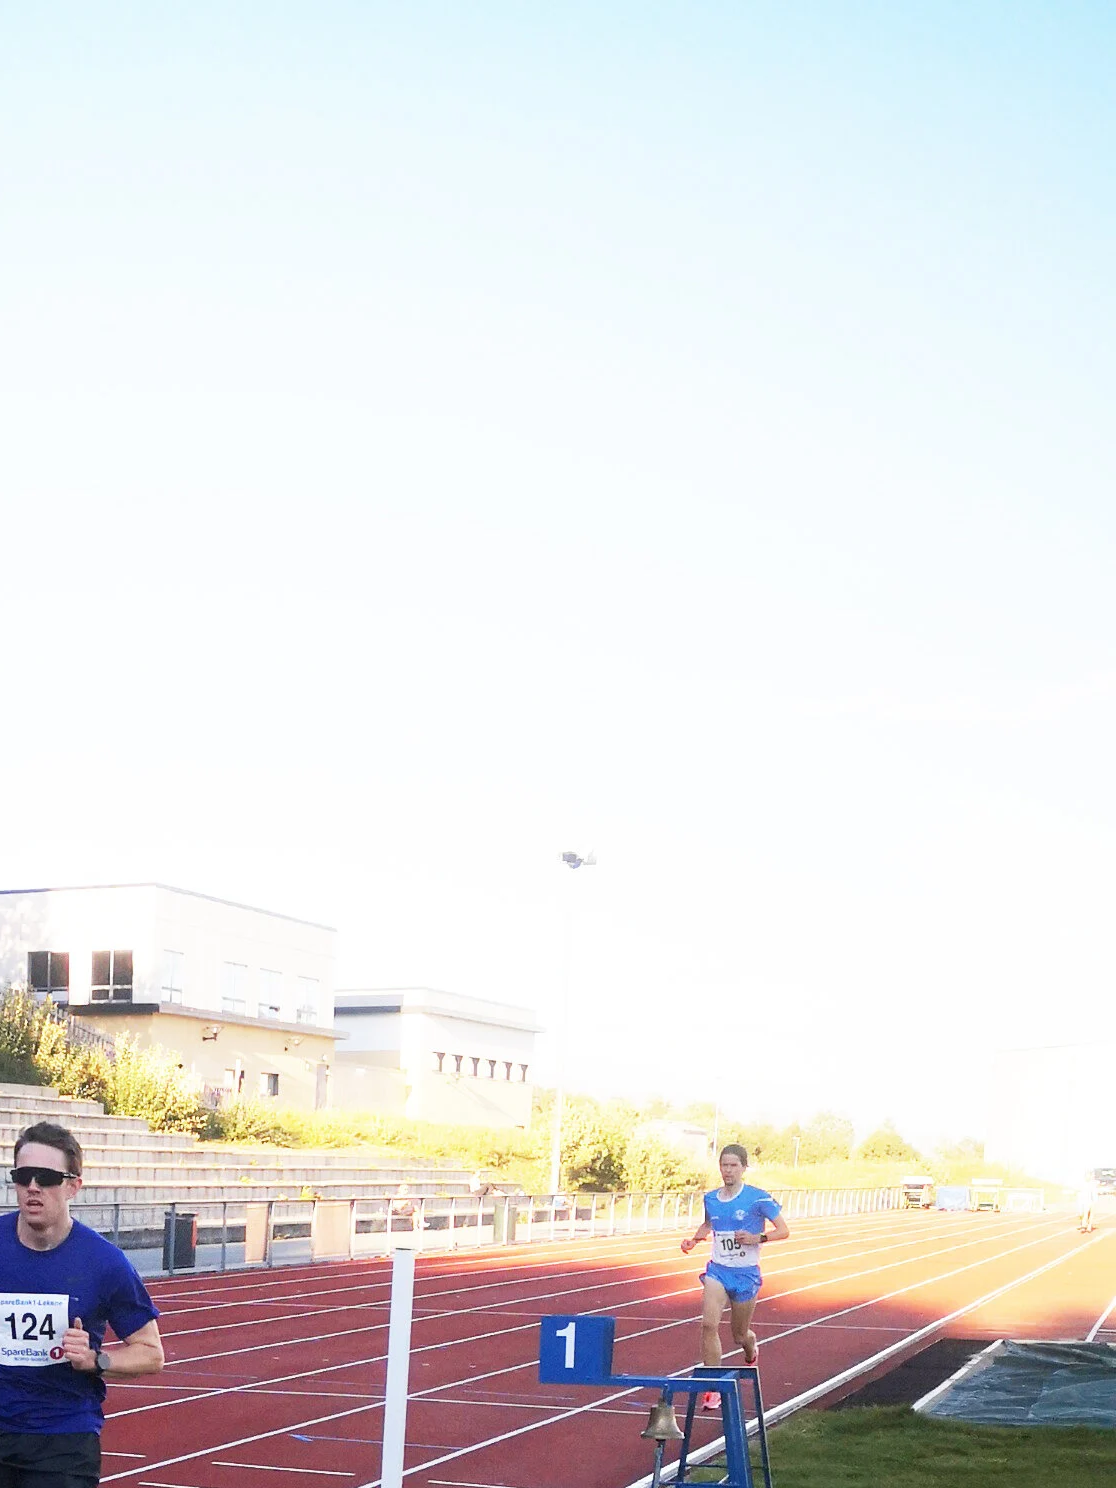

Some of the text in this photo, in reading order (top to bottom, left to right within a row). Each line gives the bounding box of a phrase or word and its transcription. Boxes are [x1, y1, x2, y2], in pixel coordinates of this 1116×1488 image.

[720, 1238, 741, 1251] 105
[4, 1312, 56, 1341] 124
[1, 1347, 48, 1357] SpareBank
[556, 1322, 576, 1369] 1
